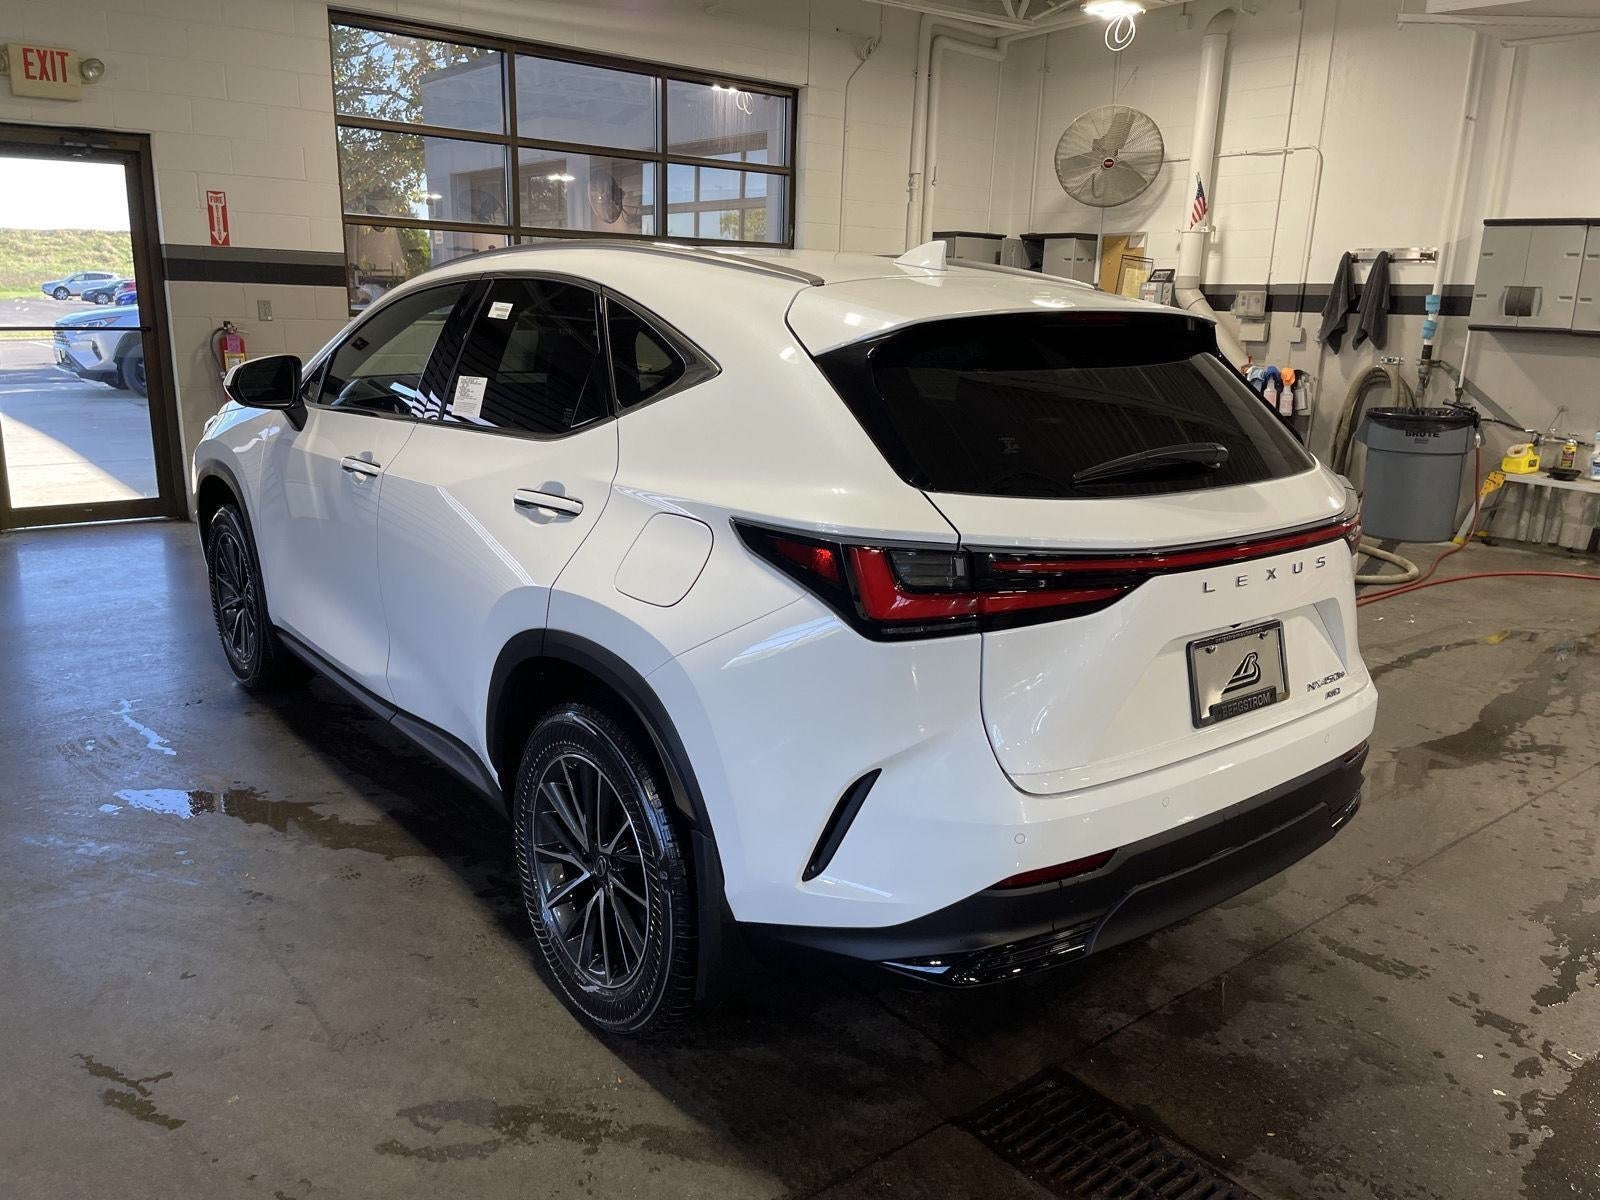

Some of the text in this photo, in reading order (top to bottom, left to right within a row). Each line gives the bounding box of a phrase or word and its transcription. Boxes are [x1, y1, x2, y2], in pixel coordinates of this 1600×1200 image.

[22, 47, 69, 83] EXIT
[209, 195, 224, 204] FIRE
[1202, 556, 1326, 593] LEXUS
[1221, 692, 1272, 719] BERGSTROM
